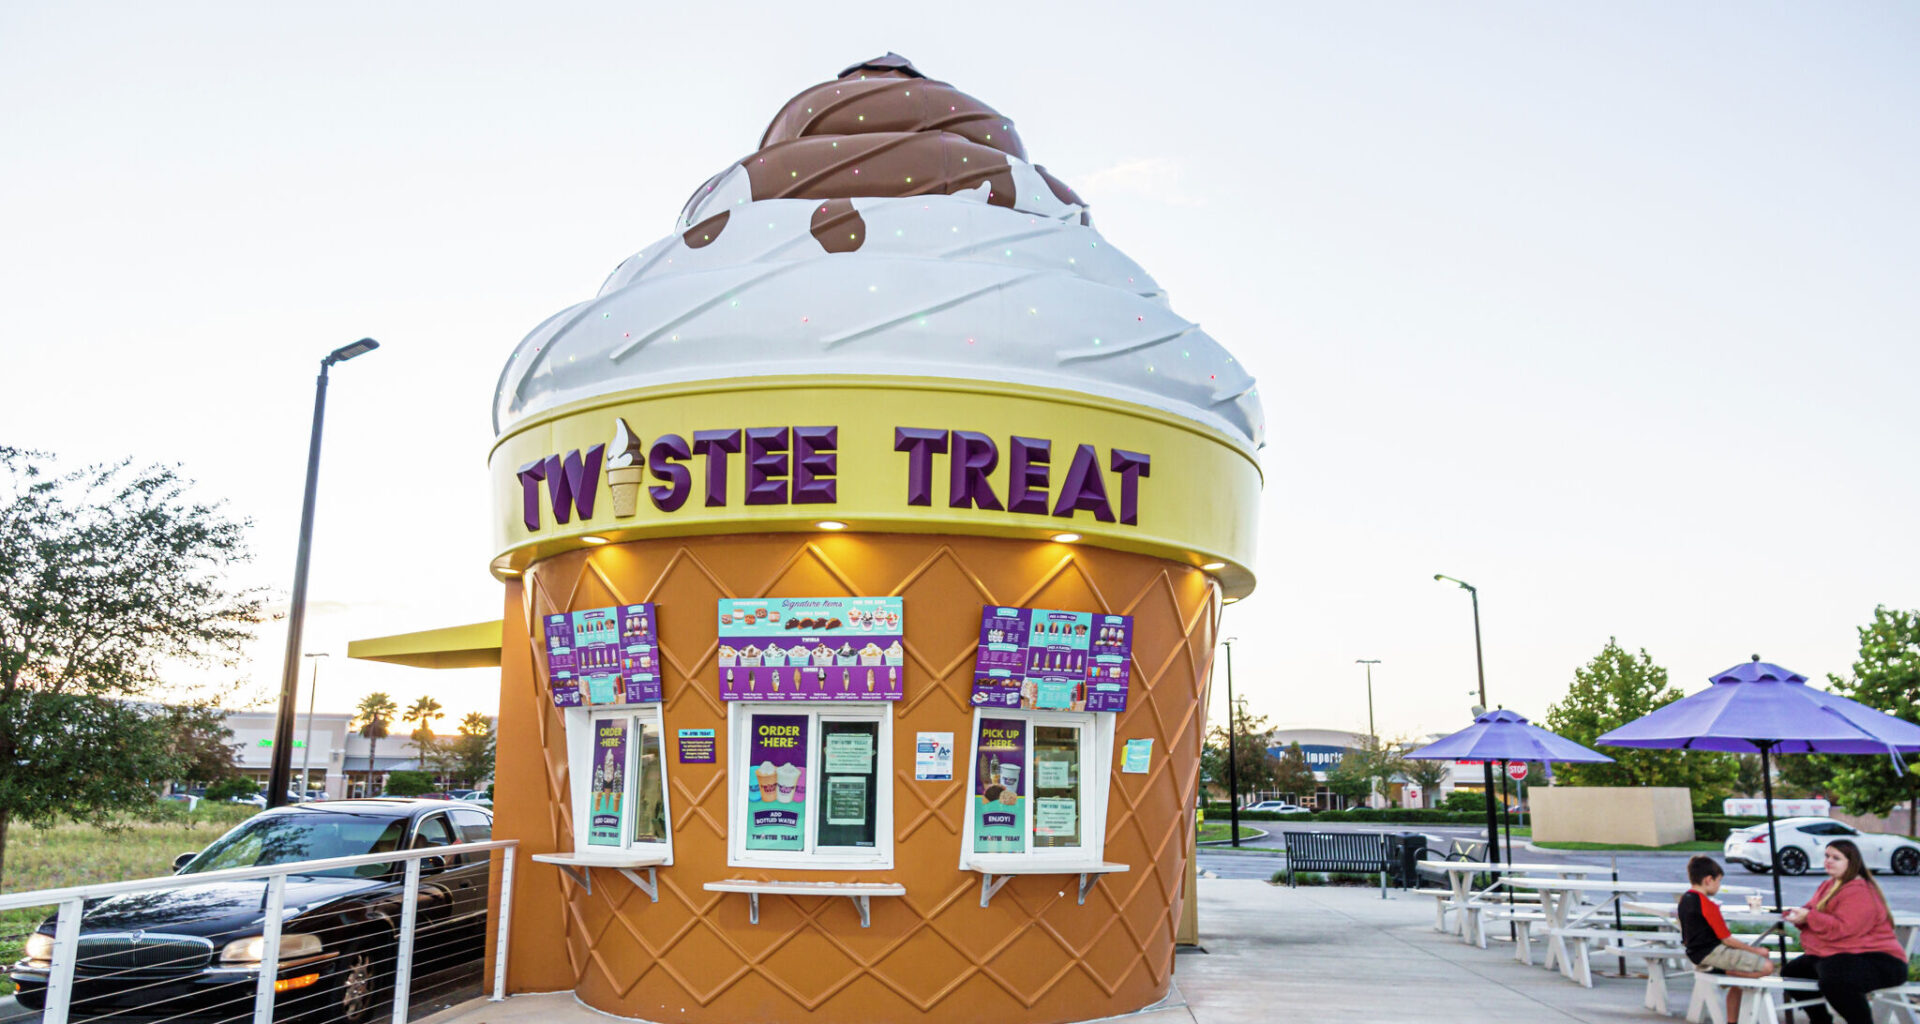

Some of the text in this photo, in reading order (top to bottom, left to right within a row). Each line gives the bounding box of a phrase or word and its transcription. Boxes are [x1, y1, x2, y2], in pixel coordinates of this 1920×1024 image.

[894, 426, 1150, 526] TREAT
[782, 599, 843, 611] Signature Items
[600, 727, 623, 737] ORDER
[759, 725, 800, 737] ORDER
[982, 728, 1020, 739] PICK UP
[1509, 765, 1526, 774] STOP
[988, 815, 1011, 823] ENJOY!
